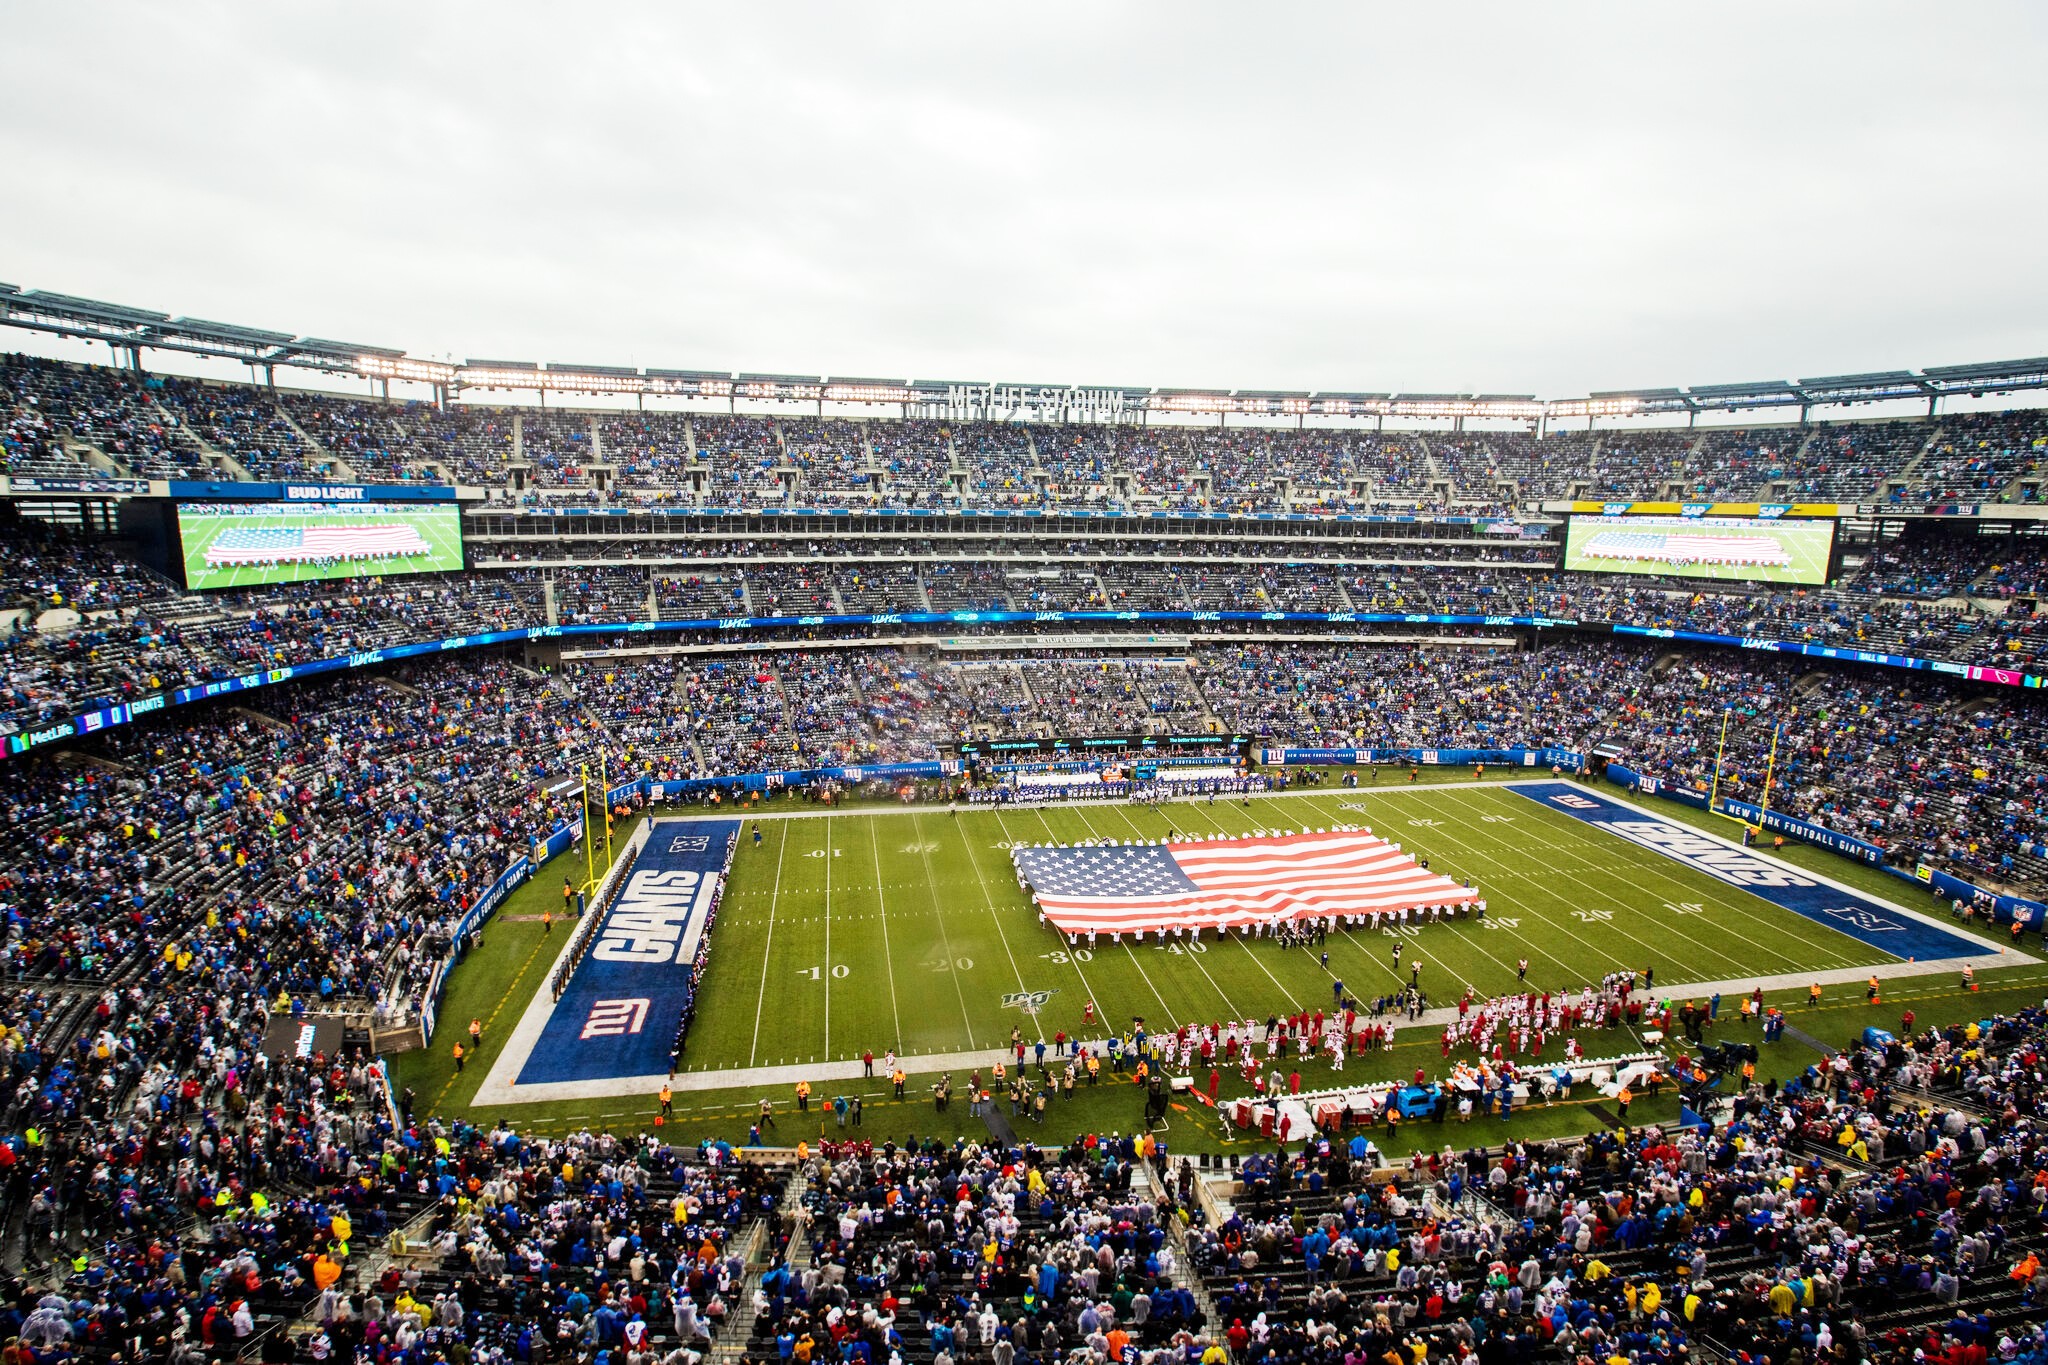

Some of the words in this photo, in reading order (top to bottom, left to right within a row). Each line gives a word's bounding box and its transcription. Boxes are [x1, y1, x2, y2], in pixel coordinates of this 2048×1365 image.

[948, 384, 1032, 410] METLIFE
[1039, 387, 1124, 413] STADIUM
[288, 486, 320, 499] BUD
[322, 487, 365, 499] LIGHT
[1603, 504, 1626, 515] SAP
[1682, 505, 1705, 516] SAP
[1760, 506, 1784, 517] SAP
[131, 696, 165, 714] GIANTS
[111, 706, 122, 724] 0
[30, 723, 74, 745] MetLife
[1267, 749, 1285, 764] ny
[1355, 750, 1371, 763] ny
[1422, 751, 1438, 764] ny
[843, 768, 861, 782] ny
[940, 760, 959, 776] ny
[766, 774, 784, 788] ny
[1638, 776, 1656, 793] ny
[1729, 804, 1750, 818] NEW
[1784, 821, 1834, 846] FOOTBALL
[1611, 821, 1817, 887] GIANTS
[1917, 866, 1930, 879] 25
[593, 869, 700, 964] GIANTS
[1570, 909, 1614, 922] 20
[1476, 917, 1518, 930] 30
[1050, 949, 1094, 964] 30
[1167, 942, 1208, 956] 40
[926, 956, 974, 972] 20
[809, 964, 850, 981] 10
[578, 998, 651, 1040] ny
